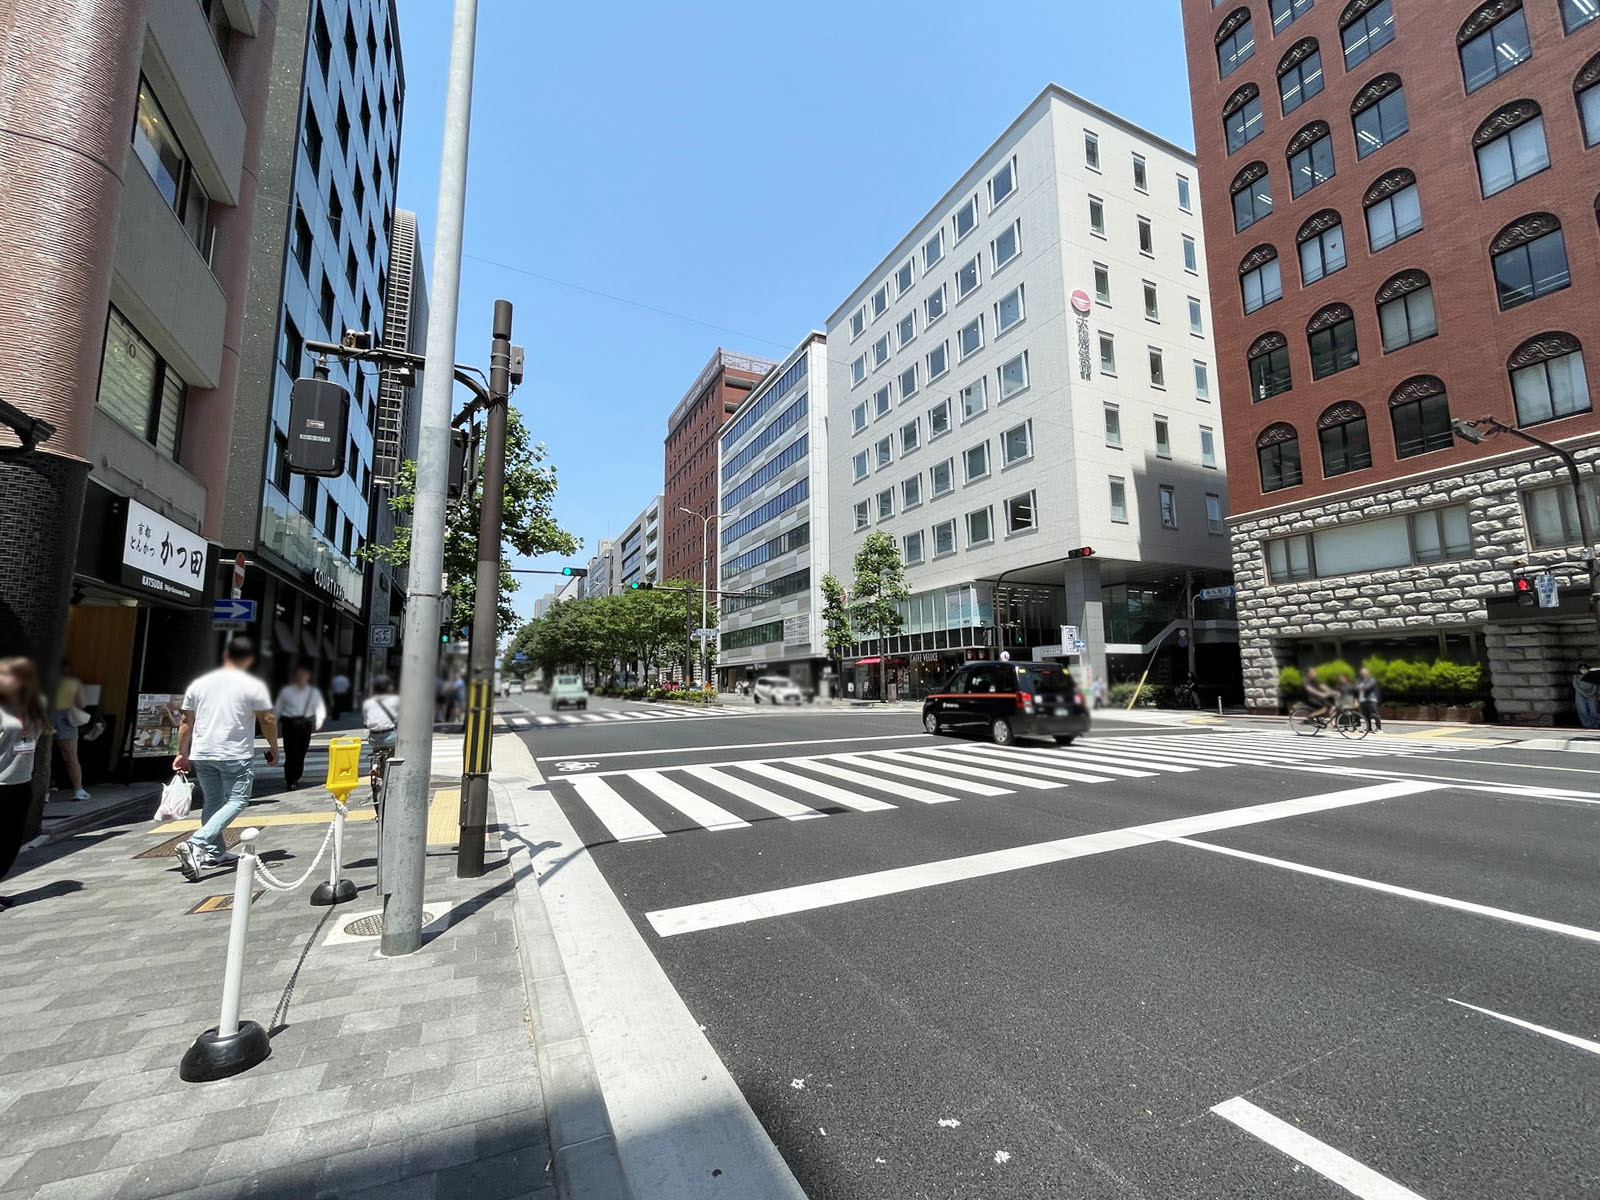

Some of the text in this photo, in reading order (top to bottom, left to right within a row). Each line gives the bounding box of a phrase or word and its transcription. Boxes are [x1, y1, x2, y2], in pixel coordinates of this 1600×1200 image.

[138, 522, 152, 540] 京都
[130, 536, 155, 557] とんかつ
[160, 531, 204, 579] かつ田
[142, 575, 163, 591] KATSUDA
[314, 567, 345, 602] COURTYARD
